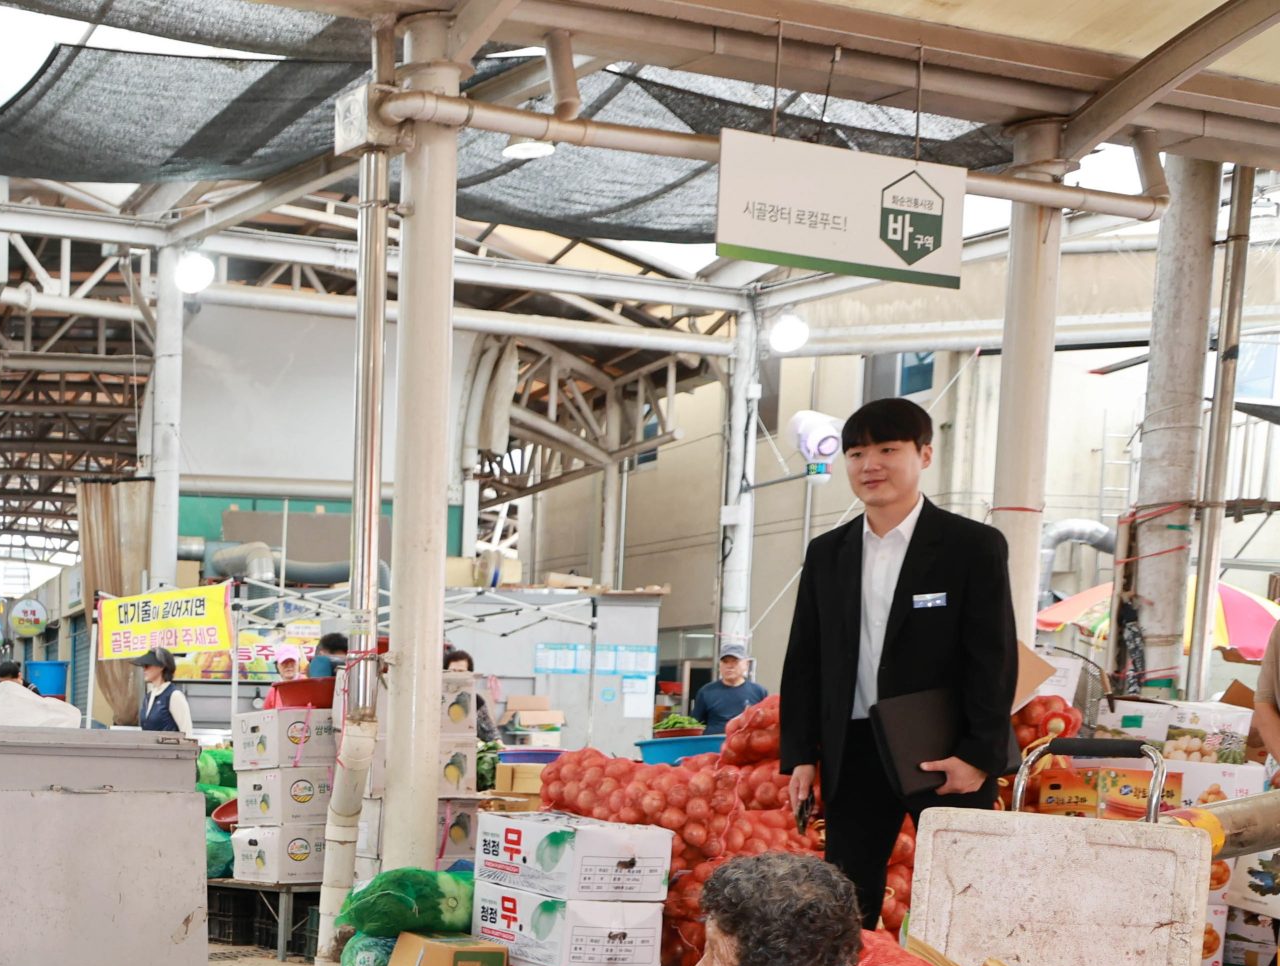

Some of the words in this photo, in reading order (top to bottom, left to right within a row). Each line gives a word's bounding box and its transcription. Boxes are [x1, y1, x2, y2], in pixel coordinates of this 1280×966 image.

[891, 194, 935, 211] 화순전통시장
[743, 199, 792, 225] 시골장터
[794, 209, 848, 232] 로컬푸드!
[887, 213, 914, 251] 바
[914, 234, 934, 251] 구역
[118, 600, 159, 624] 대기줄이
[161, 597, 206, 619] 길어지면
[112, 630, 147, 653] 골목으로
[150, 628, 178, 649] 들어와
[482, 838, 500, 857] 청정
[480, 905, 498, 924] 청정
